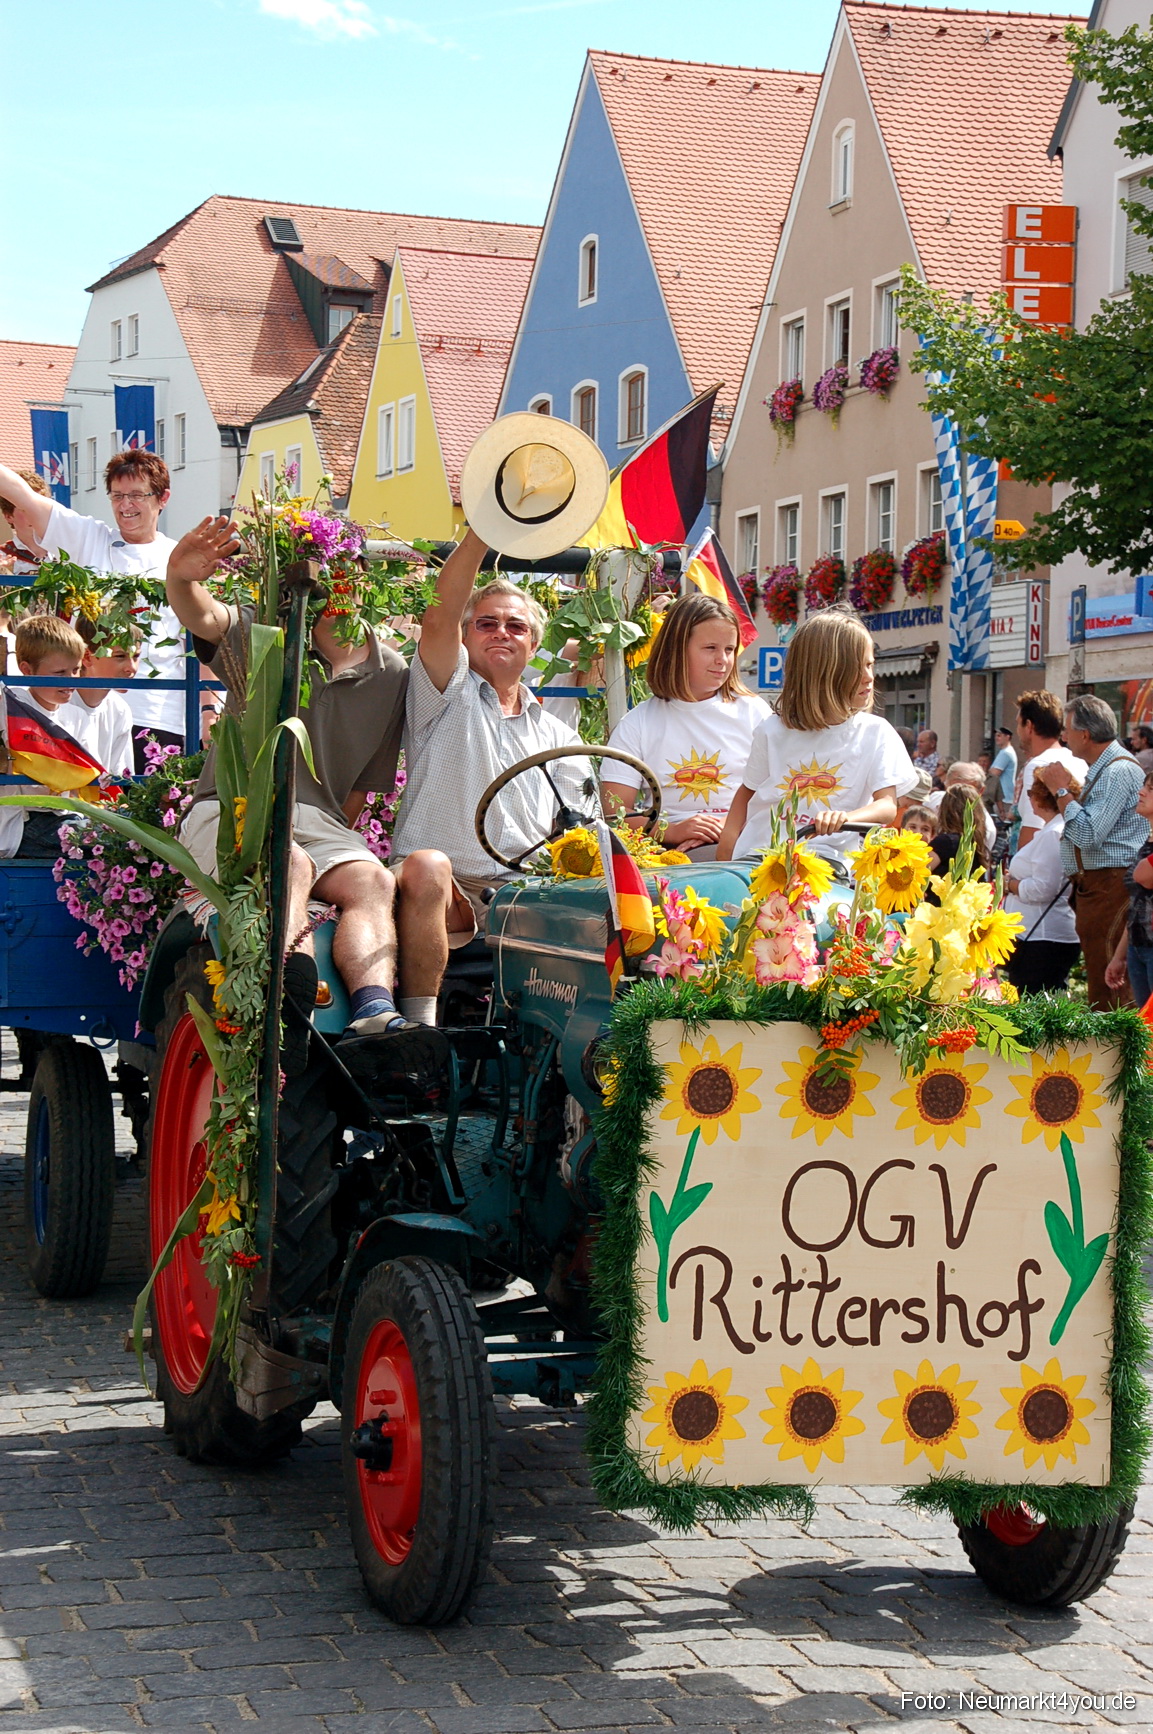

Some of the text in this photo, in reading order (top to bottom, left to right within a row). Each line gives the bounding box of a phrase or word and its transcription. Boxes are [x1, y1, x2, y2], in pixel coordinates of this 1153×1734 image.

[1008, 617, 1013, 633] 2
[1030, 585, 1041, 662] KINO
[765, 651, 783, 684] P
[523, 967, 578, 1017] Hanomag
[669, 1245, 1045, 1361] Rittershof
